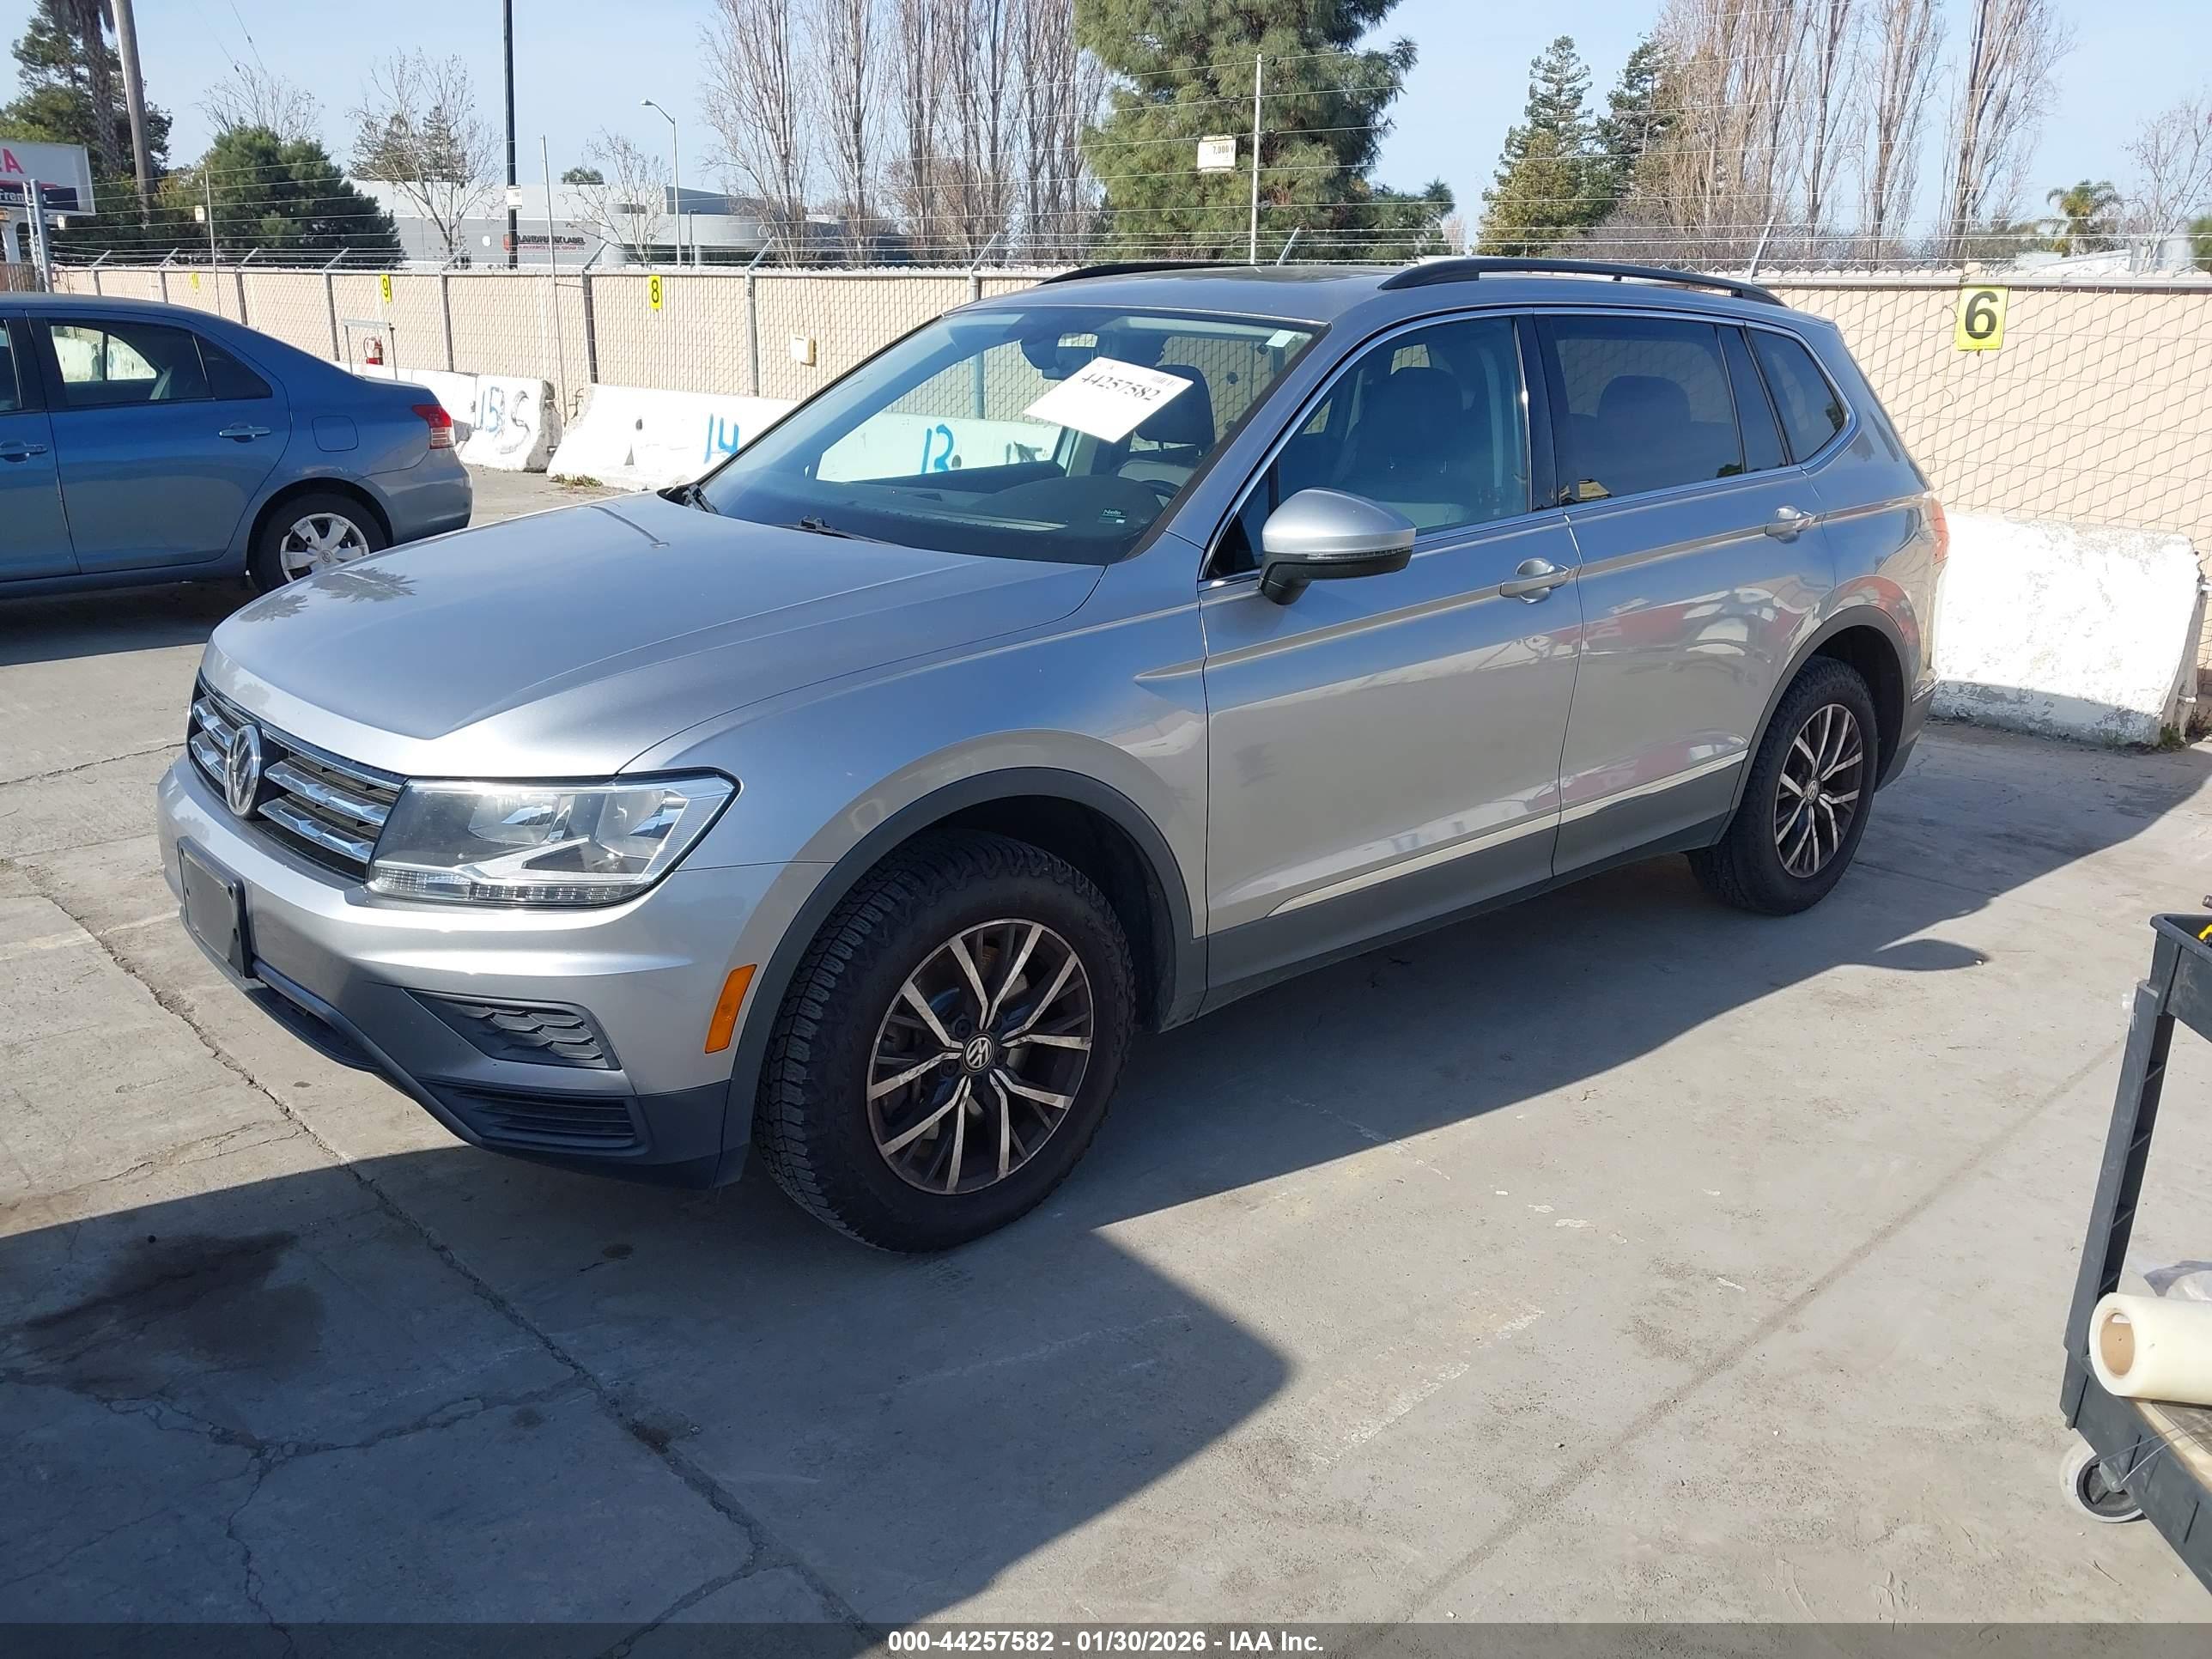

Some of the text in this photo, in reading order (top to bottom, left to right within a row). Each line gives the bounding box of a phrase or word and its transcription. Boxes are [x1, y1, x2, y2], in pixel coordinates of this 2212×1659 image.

[382, 277, 389, 298] 9
[651, 279, 659, 303] 8
[1965, 290, 1999, 340] 6
[1081, 372, 1162, 402] 44257582
